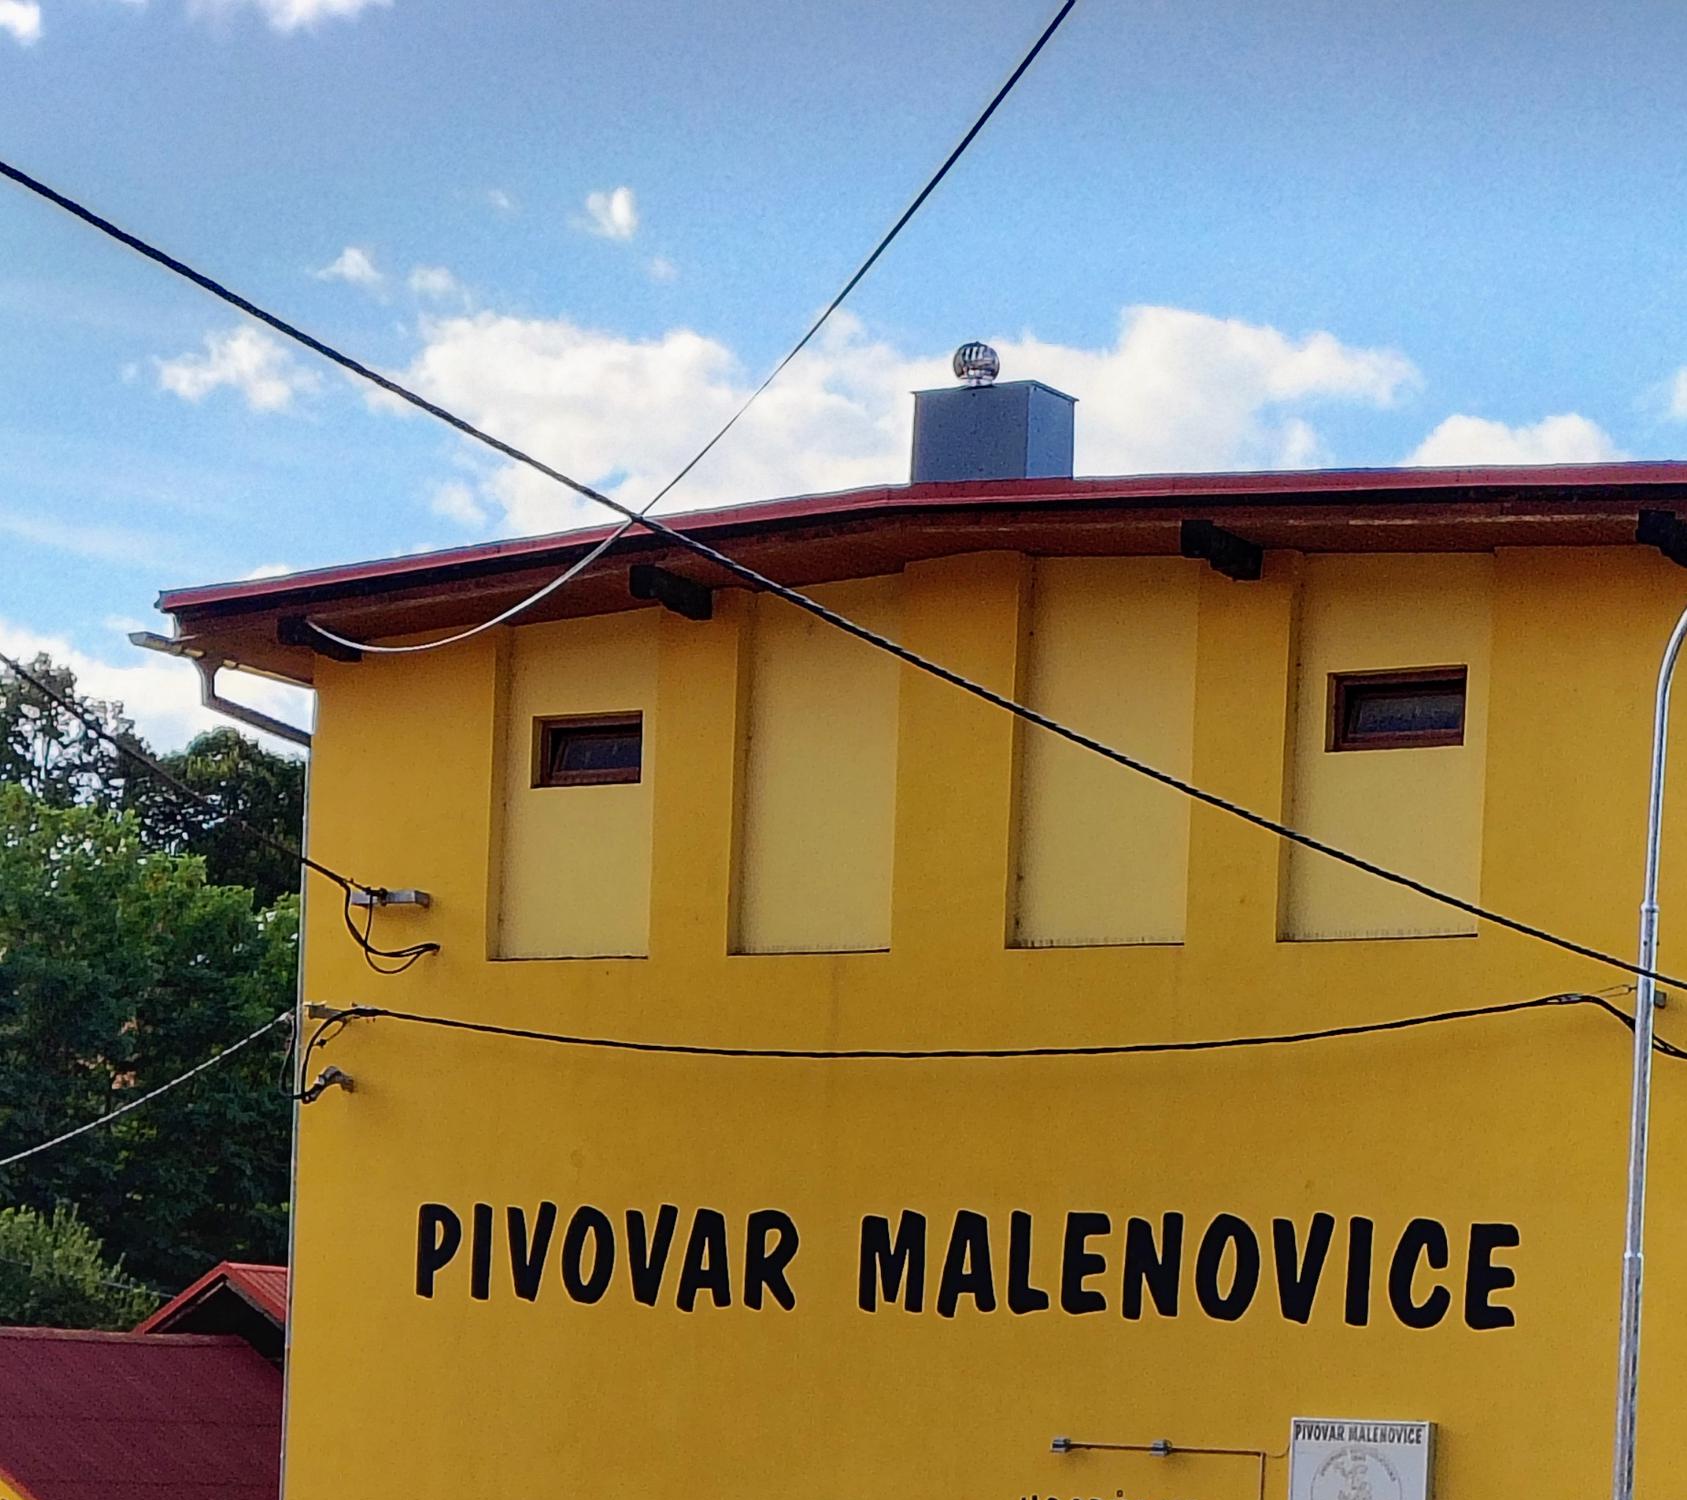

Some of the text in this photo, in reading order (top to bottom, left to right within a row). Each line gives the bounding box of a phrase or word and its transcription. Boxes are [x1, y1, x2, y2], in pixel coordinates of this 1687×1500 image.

[416, 1202, 1520, 1330] PIVOVAR MALENOVICE
[1295, 1424, 1422, 1444] PIVOVAR MALENOVICE
